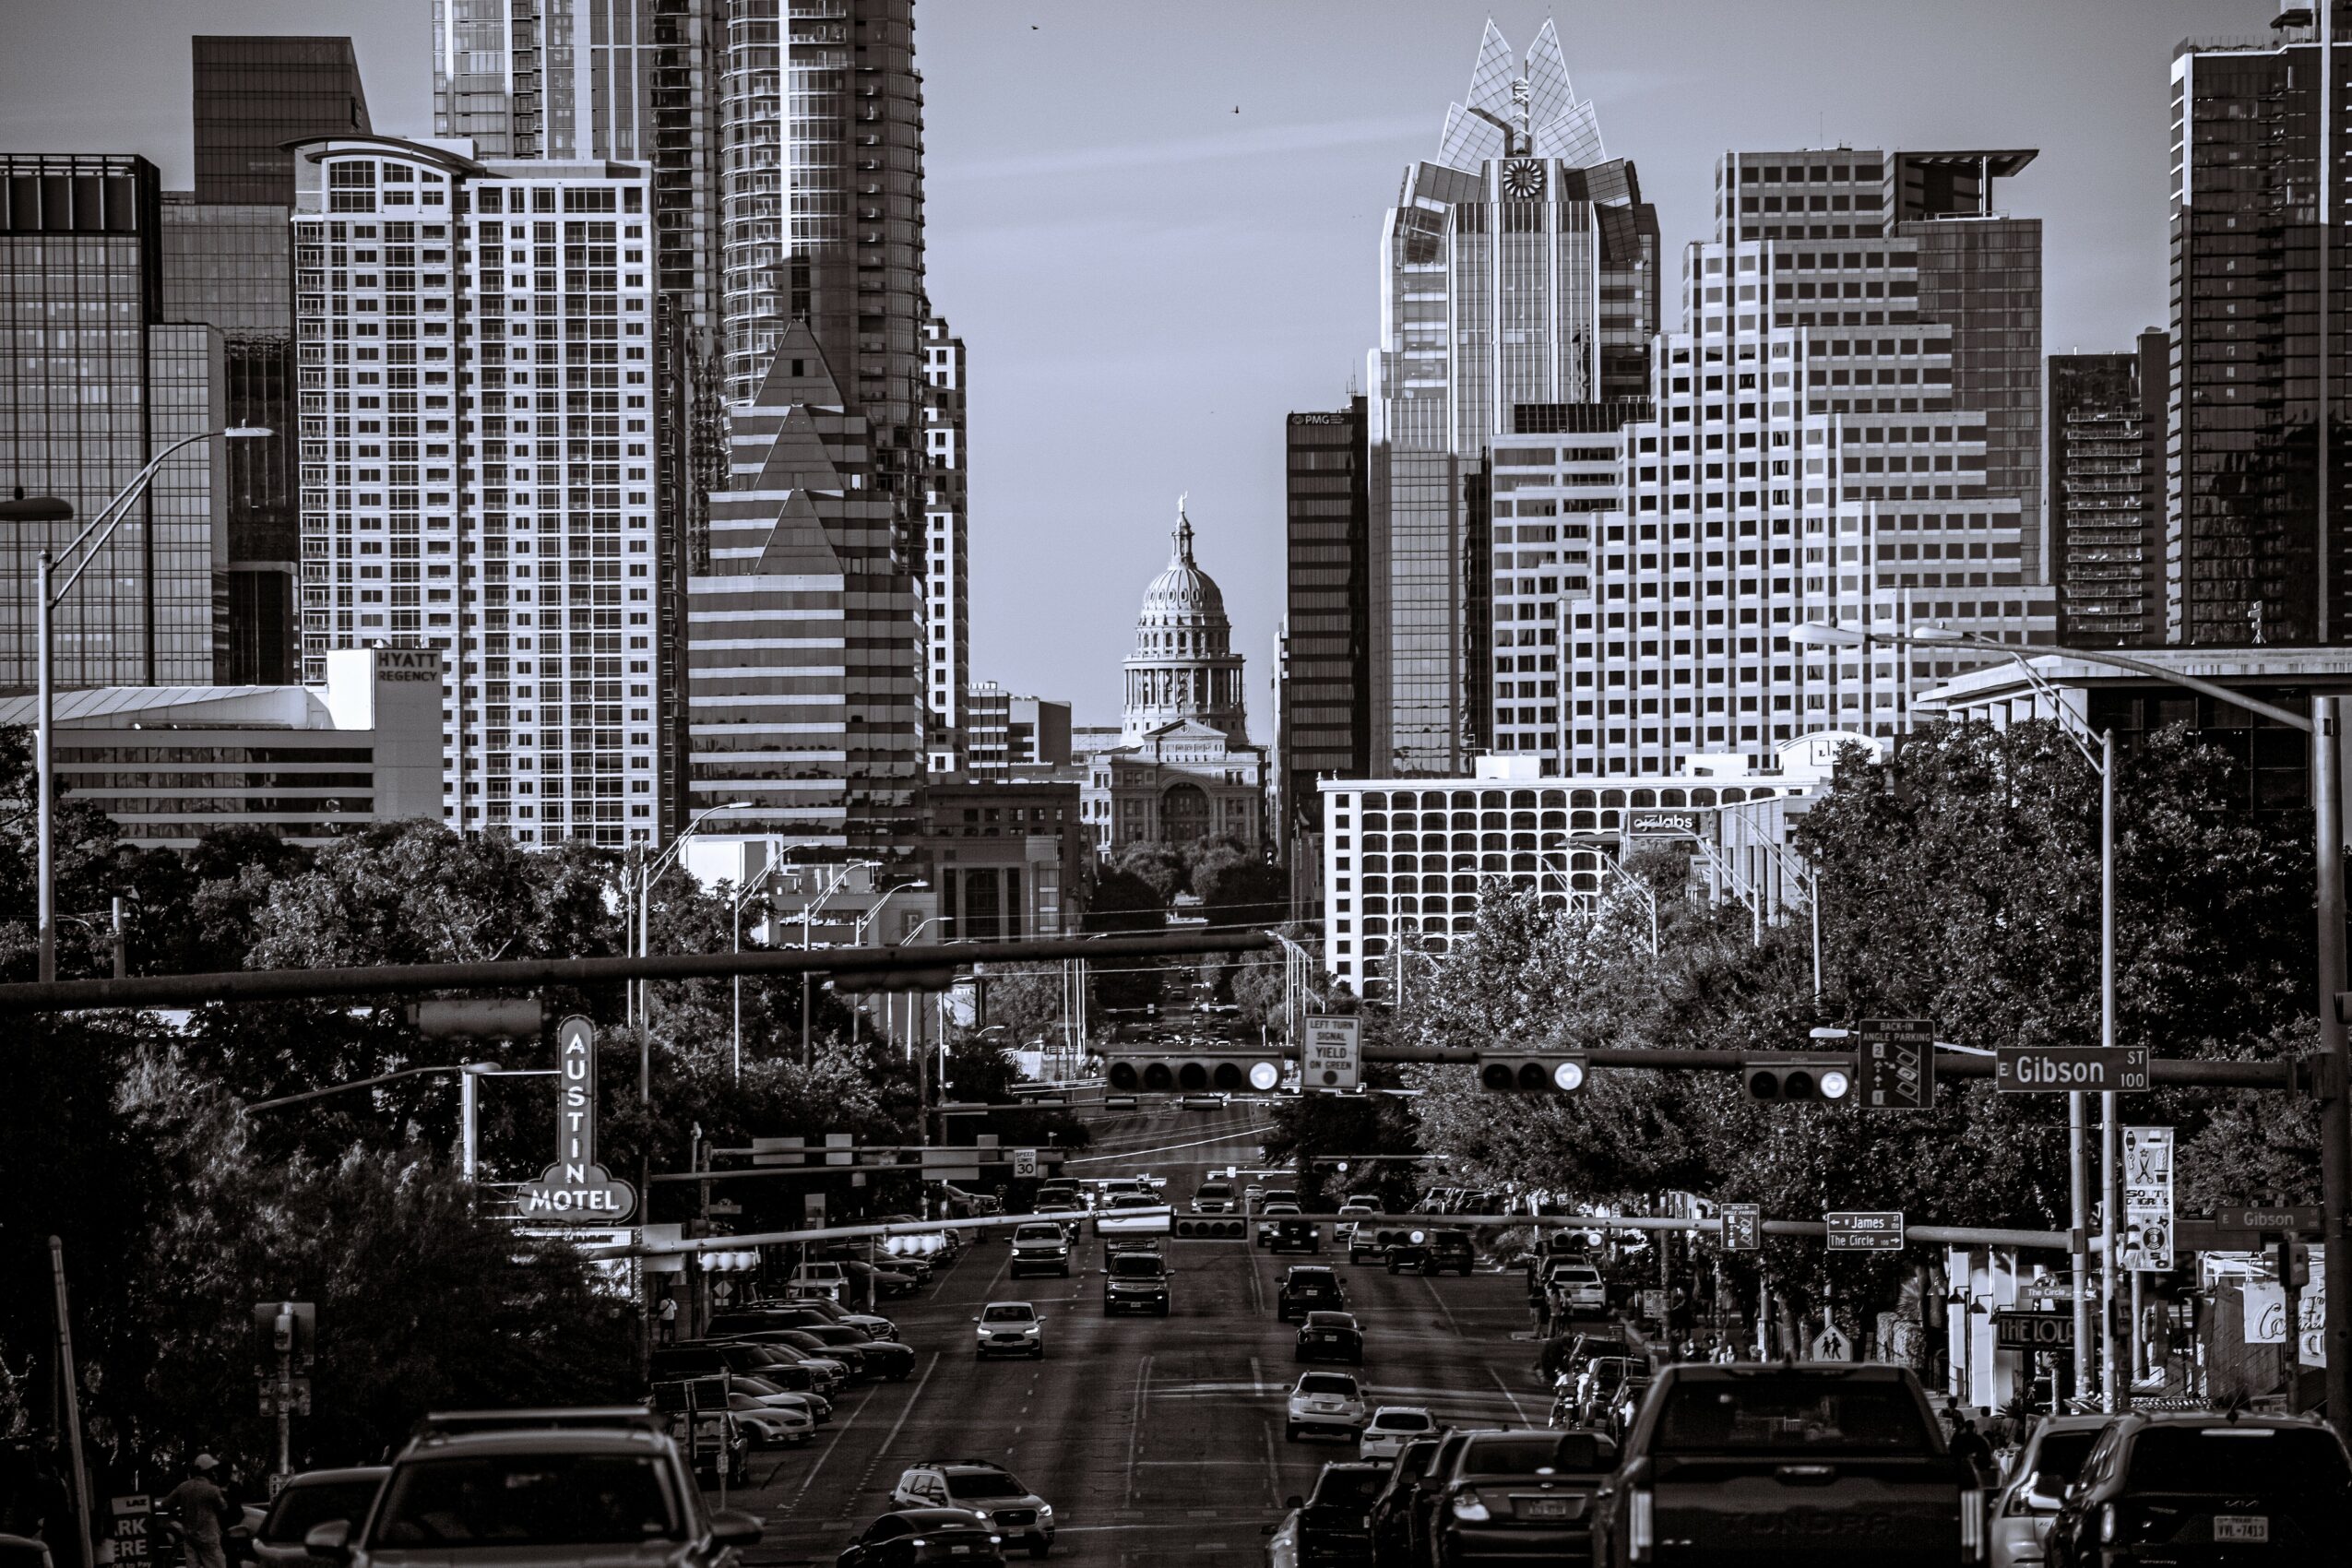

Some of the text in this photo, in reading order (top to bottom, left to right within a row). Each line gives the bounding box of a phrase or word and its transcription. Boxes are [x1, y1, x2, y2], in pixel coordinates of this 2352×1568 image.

[378, 652, 438, 668] HYATT
[378, 671, 438, 681] REGENCY
[1310, 1020, 1354, 1029] LEFT TURN
[1880, 1022, 1914, 1031] BACK-IN
[1317, 1032, 1346, 1041] SIGNAL
[1862, 1032, 1931, 1042] ANGLE PARKING
[1316, 1047, 1347, 1058] YIELD
[1310, 1061, 1352, 1070] ON GREEN
[2000, 1051, 2144, 1083] E Gibson ST
[2121, 1073, 2144, 1087] 100
[565, 1032, 586, 1184] AUSTIN
[1017, 1163, 1034, 1174] 30
[529, 1188, 622, 1211] MOTEL
[1851, 1216, 1885, 1229] James
[2222, 1214, 2229, 1224] E
[2243, 1211, 2295, 1226] Gibson
[1830, 1234, 1847, 1247] The
[1849, 1234, 1875, 1247] Circle
[2044, 1288, 2066, 1296] Circle
[2000, 1319, 2032, 1343] THE
